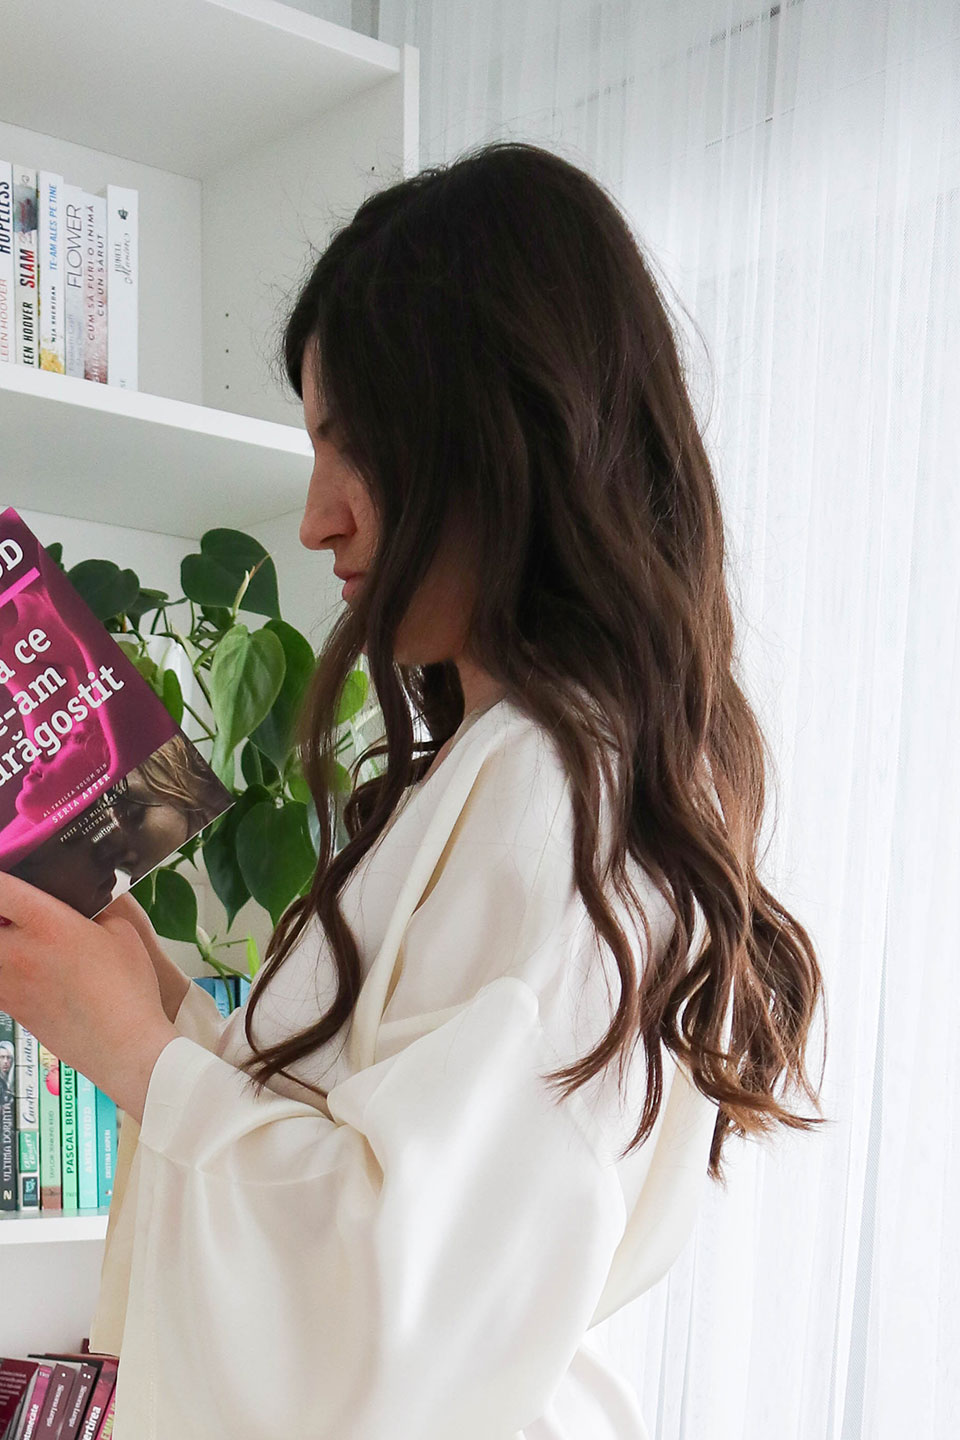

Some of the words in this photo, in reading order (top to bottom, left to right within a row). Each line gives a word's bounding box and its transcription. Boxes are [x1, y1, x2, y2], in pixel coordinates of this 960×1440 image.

[49, 183, 57, 204] TINE
[50, 207, 57, 219] PE
[49, 221, 57, 242] ALES
[66, 204, 82, 289] FLOWER
[20, 249, 36, 289] SLAM
[49, 245, 58, 270] TE-AM
[22, 302, 34, 338] HOOVER
[14, 628, 52, 665] ce
[51, 799, 80, 824] SERIA
[81, 773, 111, 800] AFTER
[82, 814, 106, 835] LECTURI
[92, 820, 120, 843] wattpad
[83, 1106, 92, 1137] TODD
[83, 1142, 93, 1173] ANNA
